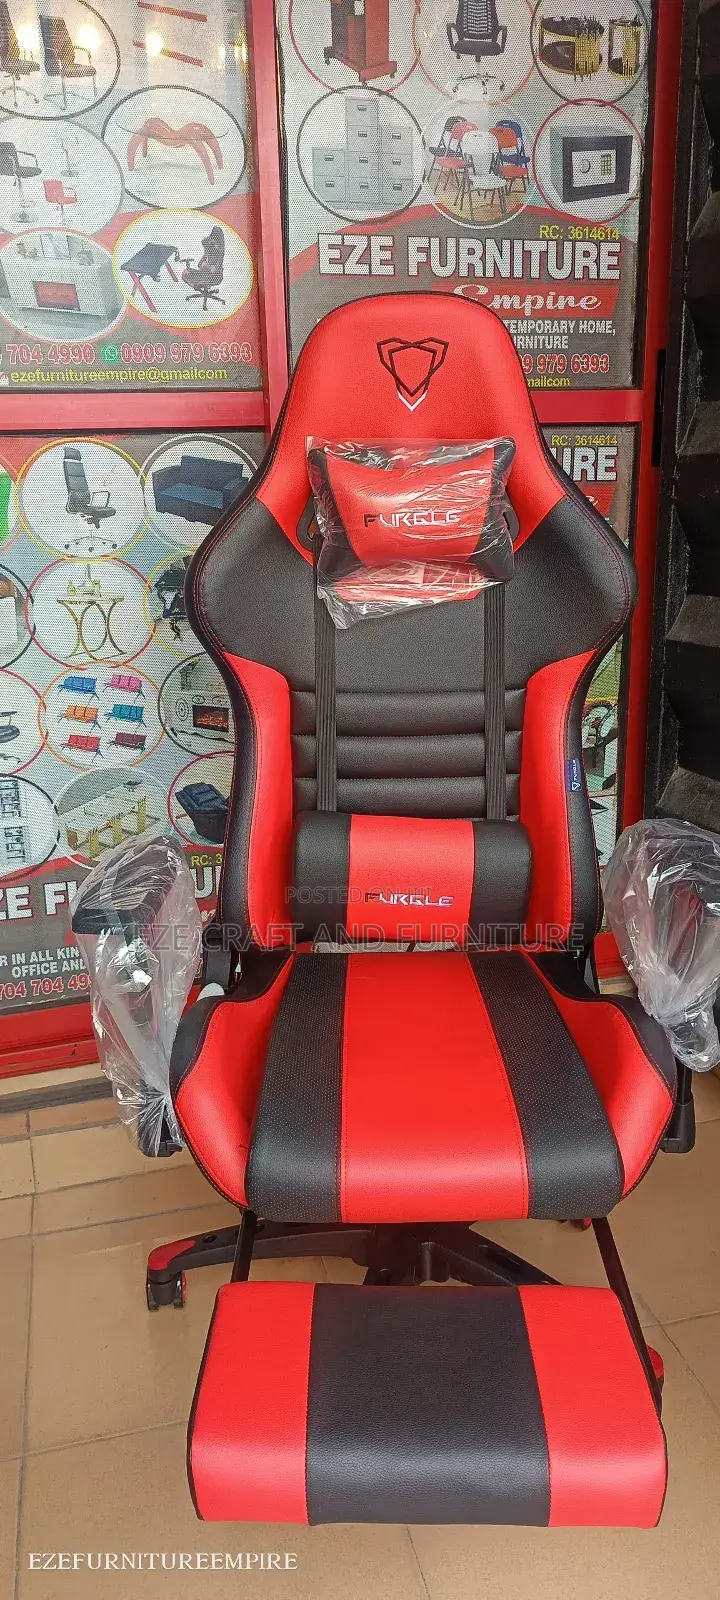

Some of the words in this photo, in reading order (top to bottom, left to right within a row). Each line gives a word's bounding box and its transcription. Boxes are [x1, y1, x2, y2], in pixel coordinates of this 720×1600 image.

[539, 225, 563, 239] RC:
[567, 227, 619, 240] 3614614
[318, 233, 395, 275] EZE
[407, 236, 621, 280] FURNITURE
[579, 320, 616, 336] HOME,
[5, 343, 43, 365] 704
[47, 343, 95, 365] 4990
[121, 342, 166, 364] 0909
[170, 342, 204, 363] 979
[208, 341, 252, 363] 6393
[536, 353, 567, 374] 979
[570, 353, 610, 374] 6393
[551, 435, 571, 446] RC:
[574, 435, 618, 446] 3614614
[191, 854, 212, 866] RC:
[11, 952, 26, 965] IN
[30, 949, 54, 963] ALL
[11, 961, 58, 978] OFFICE
[30, 976, 64, 996] 704
[68, 973, 91, 990] 49
